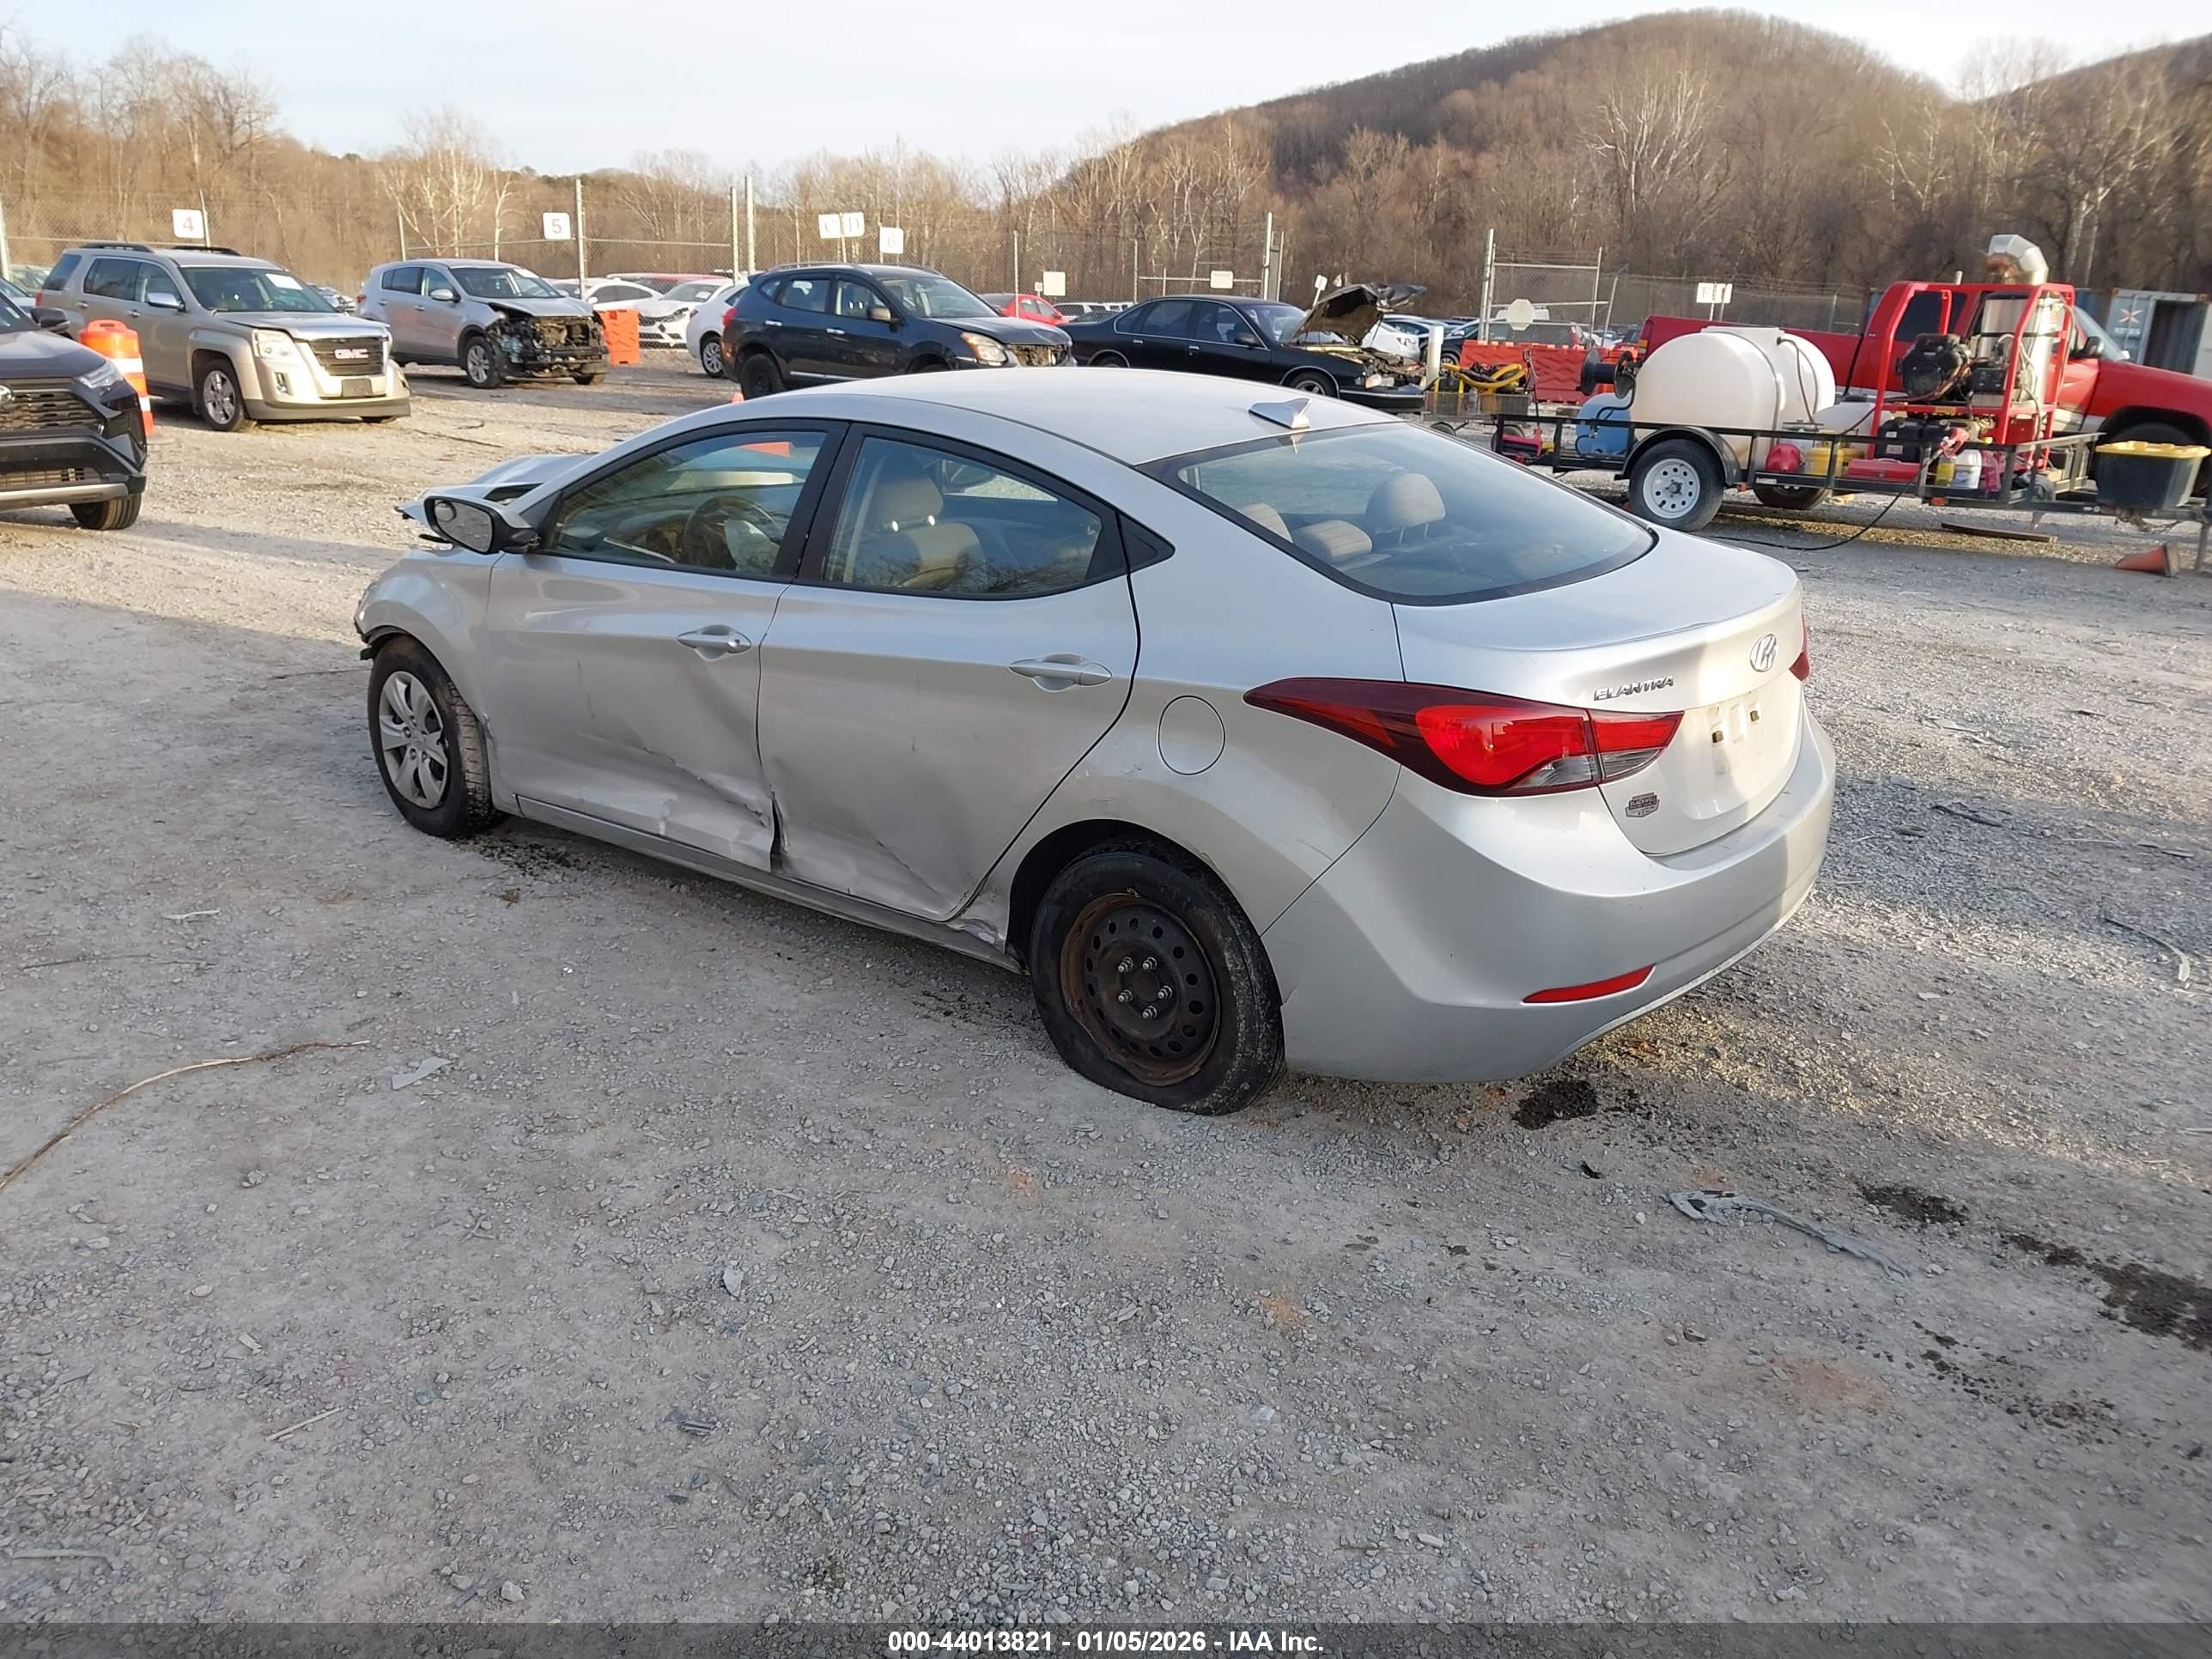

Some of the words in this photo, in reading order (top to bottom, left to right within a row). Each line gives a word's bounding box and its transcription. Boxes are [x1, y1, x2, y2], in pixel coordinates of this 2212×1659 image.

[183, 217, 194, 232] 4
[552, 218, 562, 234] 5
[887, 234, 896, 248] 6
[335, 349, 368, 359] GMC
[1594, 676, 1674, 701] ELANTRA
